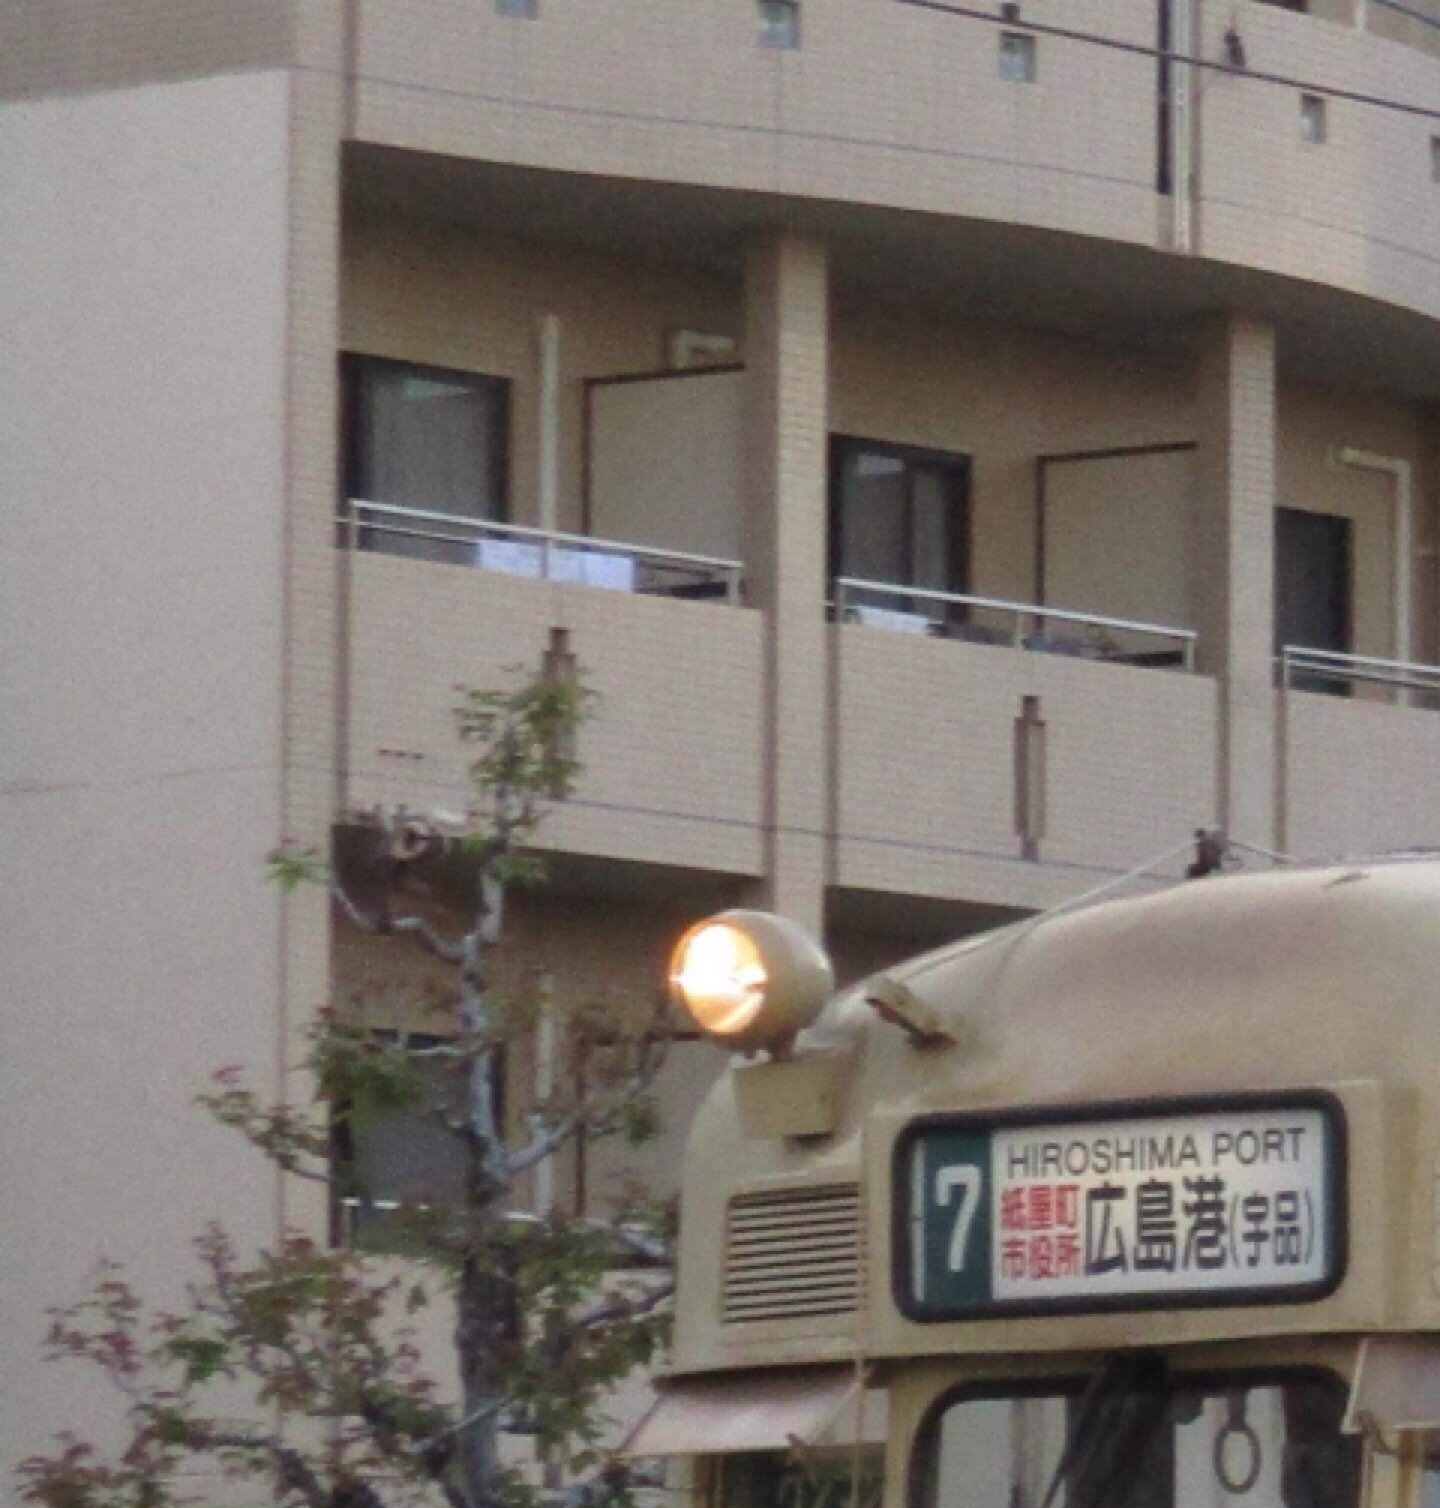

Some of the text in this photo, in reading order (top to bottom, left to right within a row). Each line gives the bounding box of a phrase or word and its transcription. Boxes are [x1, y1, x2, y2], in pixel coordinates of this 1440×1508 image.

[1007, 1126, 1307, 1180] HIROSHIMA PORT
[936, 1163, 982, 1273] 7
